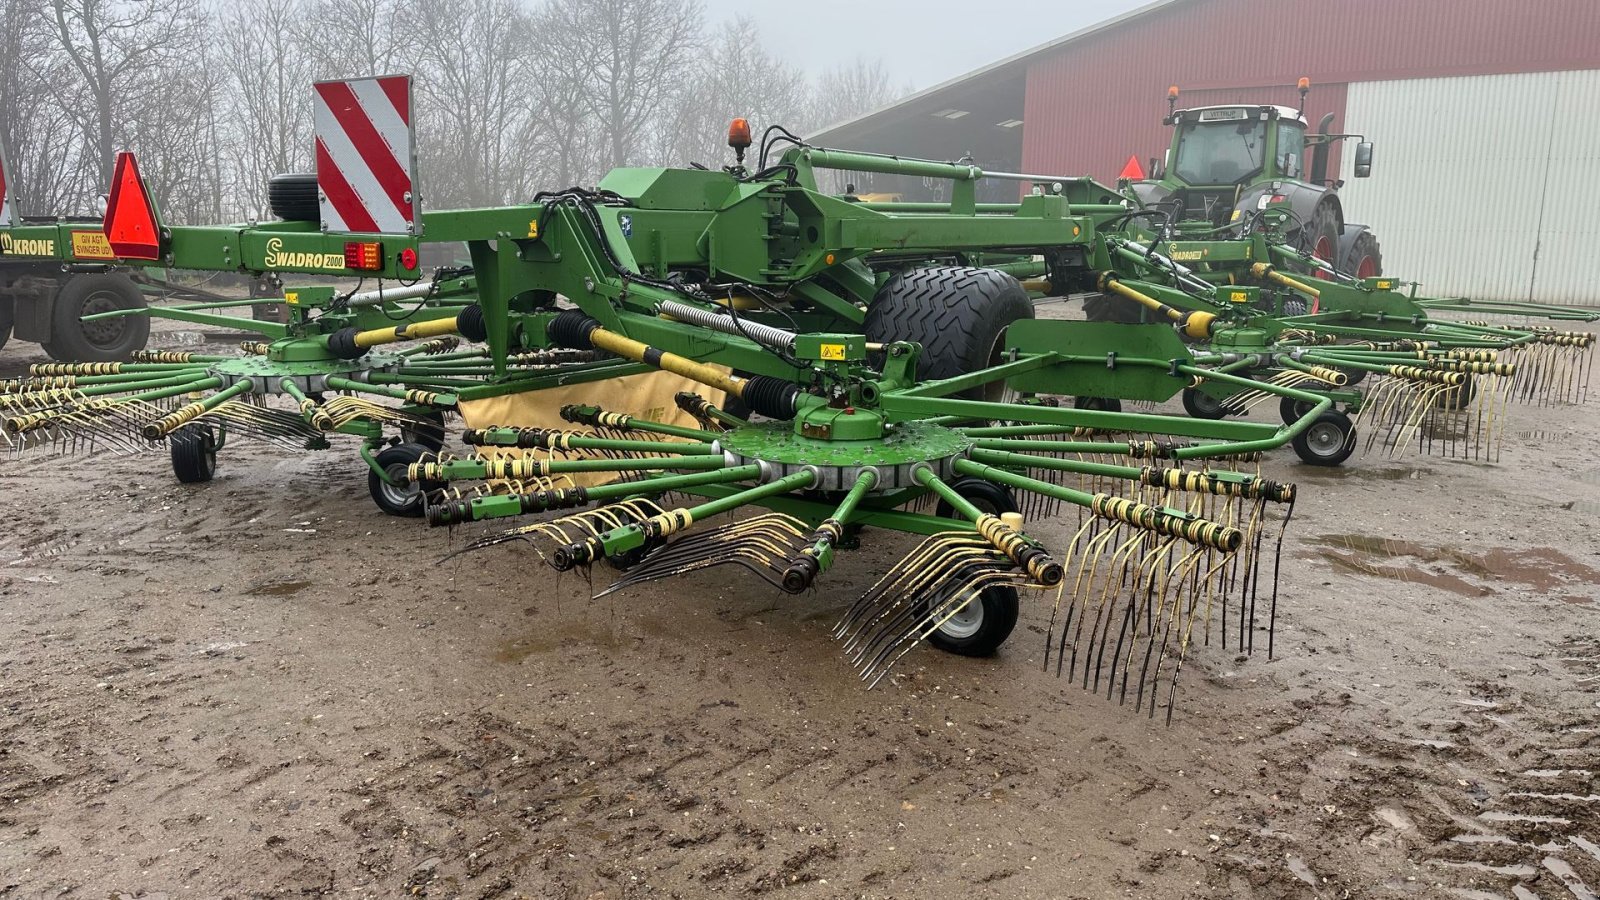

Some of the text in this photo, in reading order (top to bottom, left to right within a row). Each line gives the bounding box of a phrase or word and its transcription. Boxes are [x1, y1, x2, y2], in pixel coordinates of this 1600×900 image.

[92, 235, 103, 244] AGT
[13, 239, 54, 256] KRONE
[76, 245, 101, 255] SVINGER
[265, 238, 343, 267] SWADRO 2000
